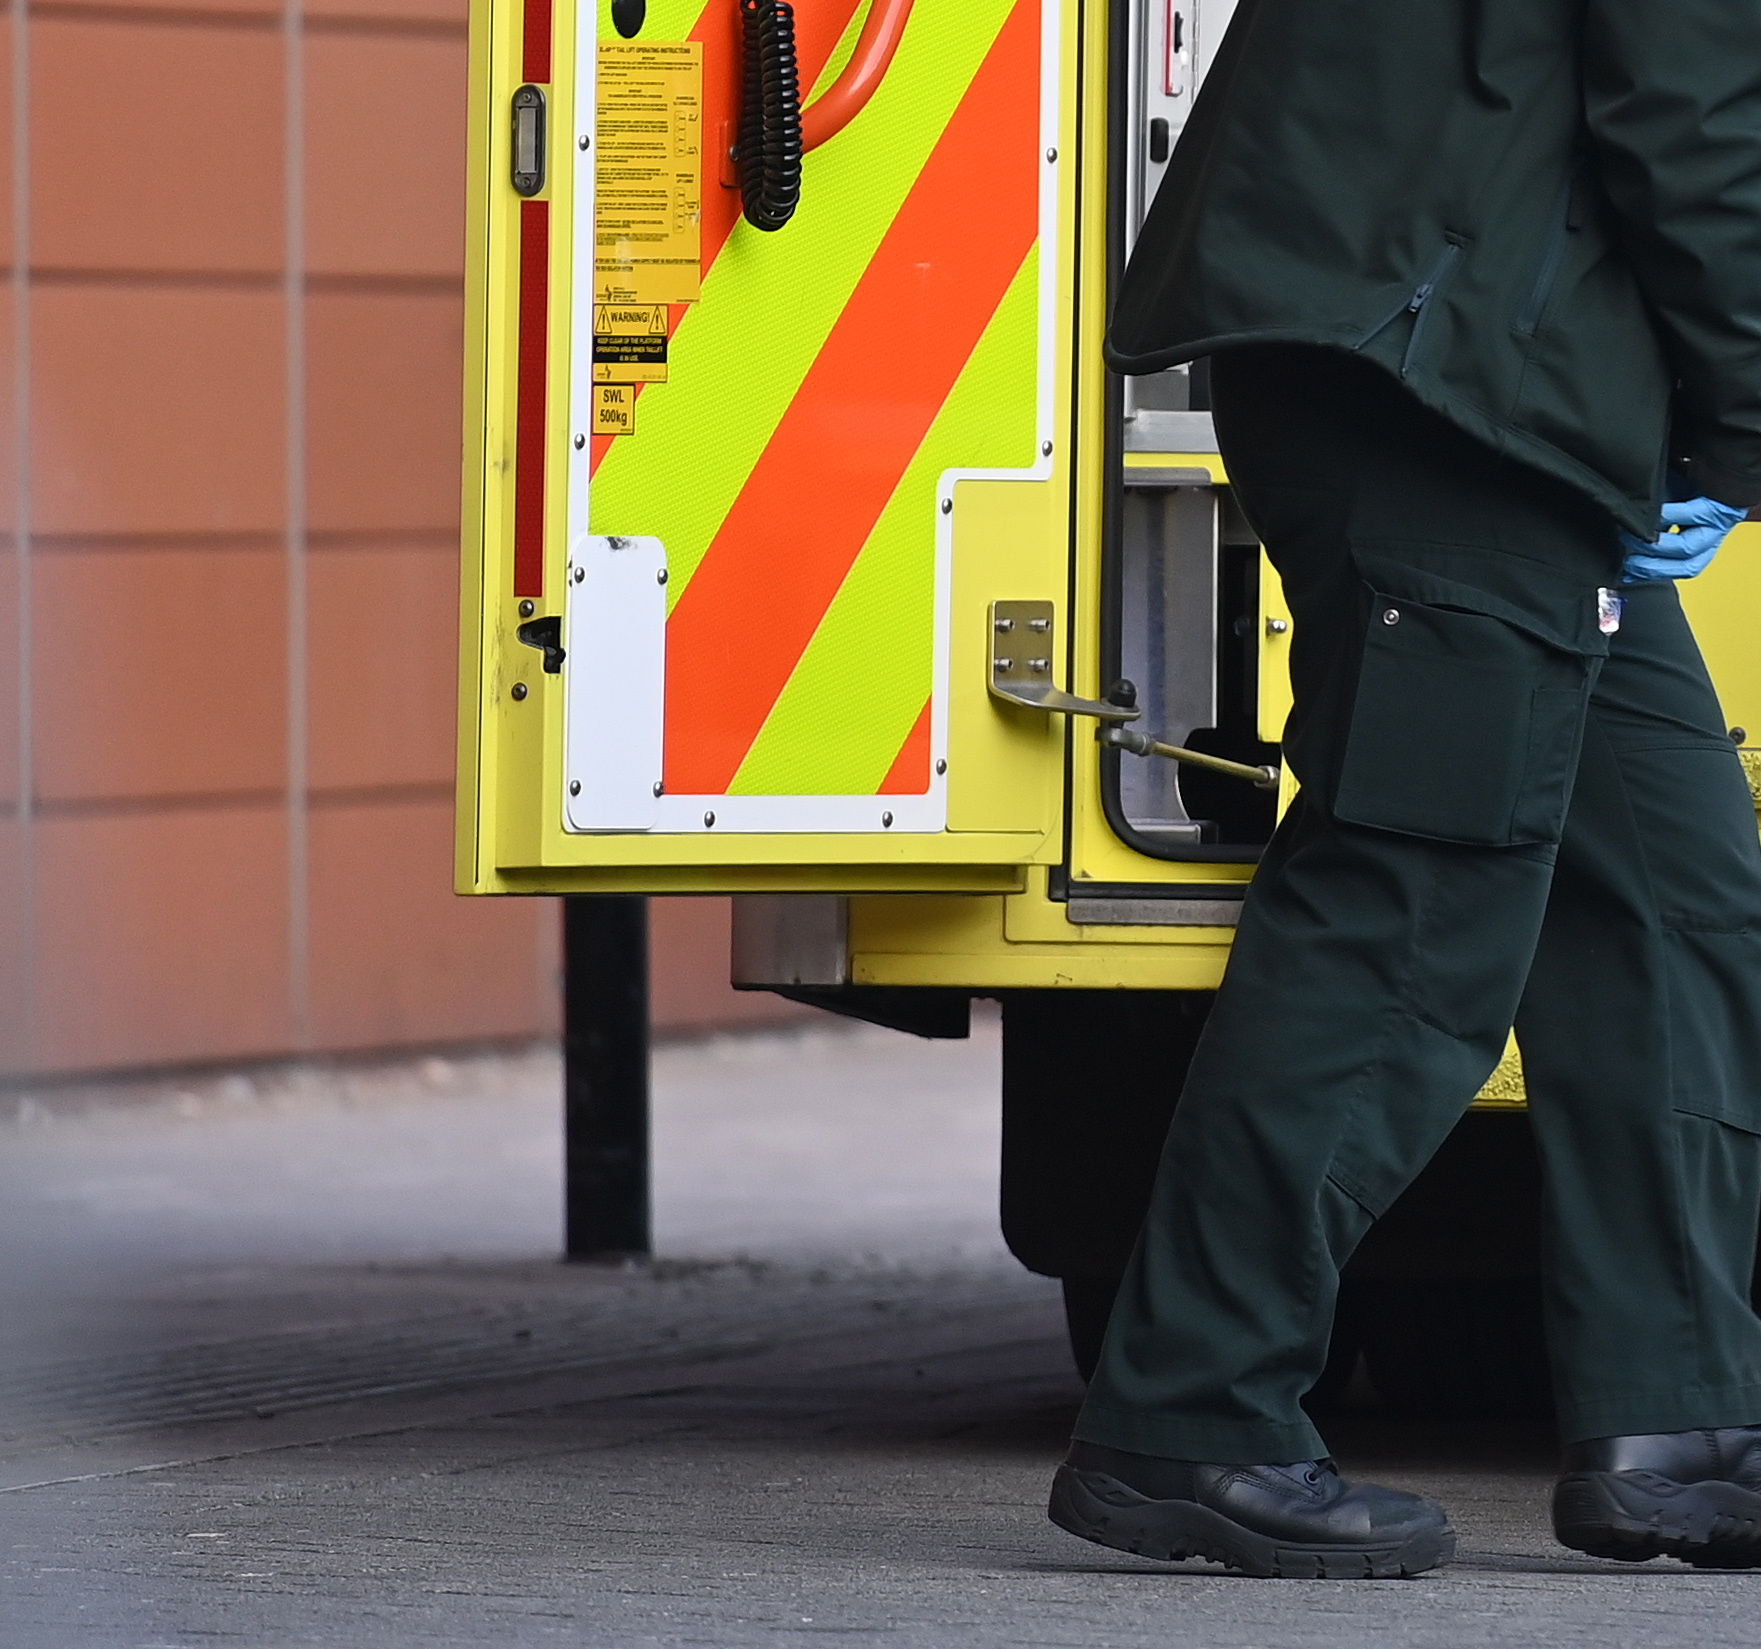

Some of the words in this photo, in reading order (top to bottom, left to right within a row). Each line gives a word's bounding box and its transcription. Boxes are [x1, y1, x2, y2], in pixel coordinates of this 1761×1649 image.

[610, 311, 651, 323] WARNING!
[603, 388, 625, 403] SWL
[599, 408, 628, 427] 500kg
